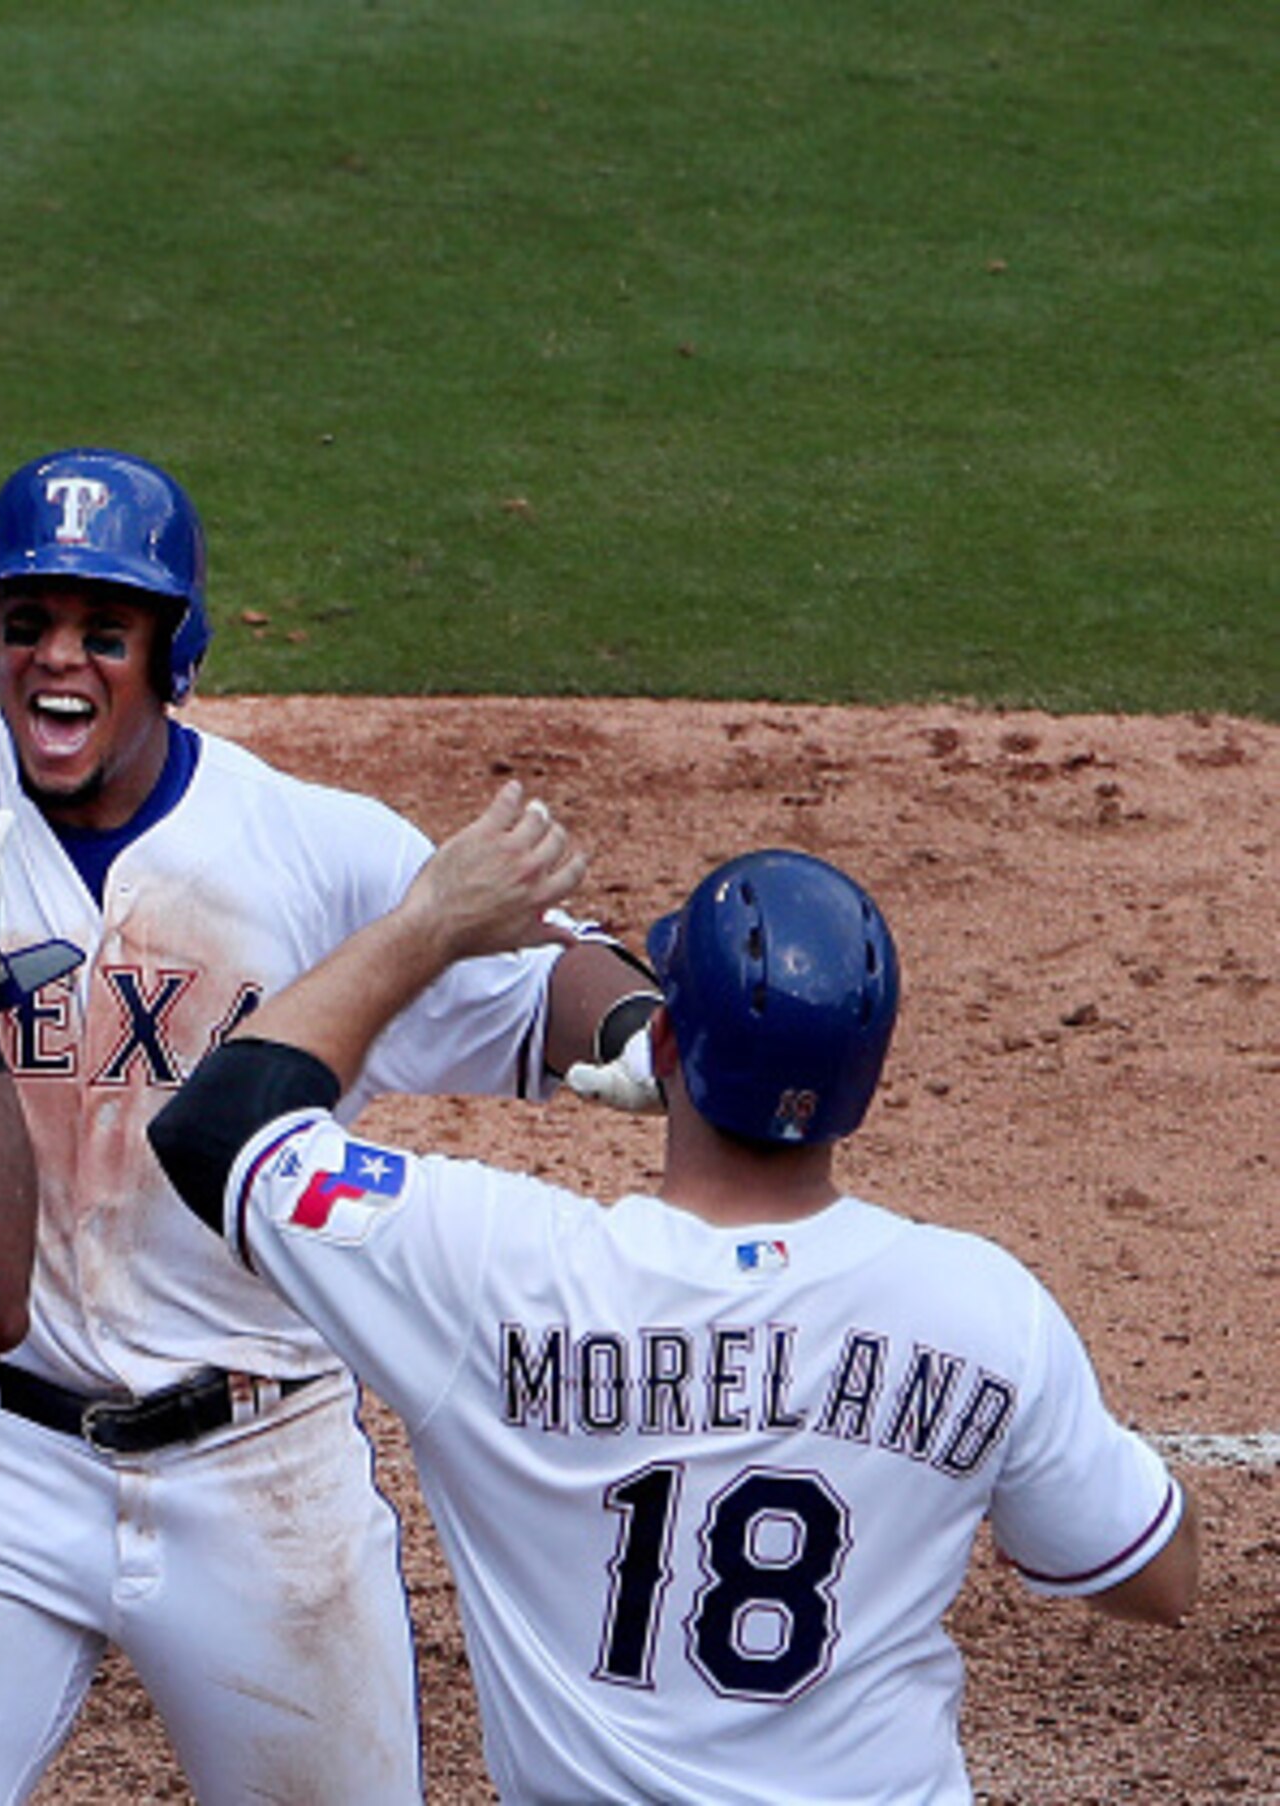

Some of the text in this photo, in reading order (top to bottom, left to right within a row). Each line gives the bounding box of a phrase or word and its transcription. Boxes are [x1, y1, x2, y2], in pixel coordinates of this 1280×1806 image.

[46, 478, 109, 545] T
[500, 1321, 1018, 1480] MORELAND
[589, 1460, 854, 1703] 18
